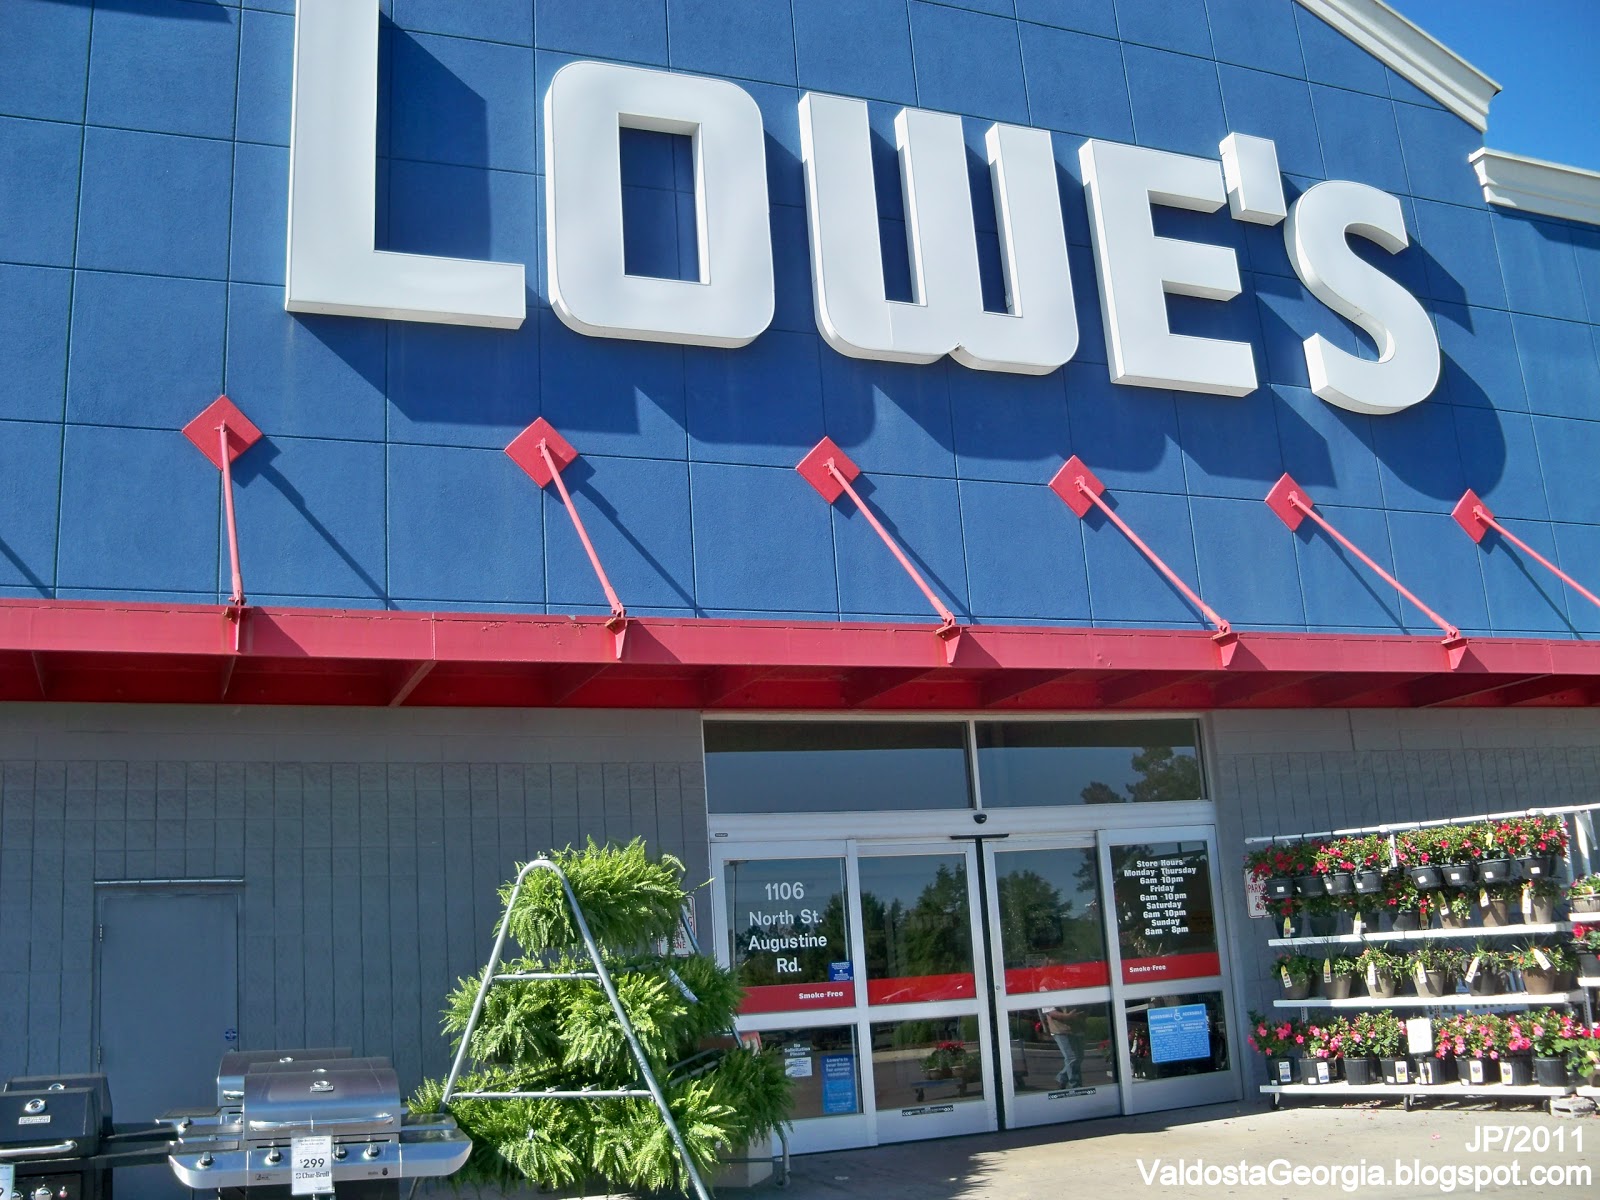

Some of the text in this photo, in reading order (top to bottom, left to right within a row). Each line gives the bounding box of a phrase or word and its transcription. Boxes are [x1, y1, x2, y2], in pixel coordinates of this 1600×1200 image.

[285, 0, 1440, 414] LOWE'S
[1136, 860, 1158, 868] Store
[1160, 867, 1197, 875] Thursday
[1140, 877, 1158, 885] 6am
[765, 881, 805, 901] 1106
[1150, 885, 1175, 893] Friday
[1140, 894, 1158, 902] 6am
[1146, 901, 1182, 910] Saturday
[749, 909, 823, 926] North St.
[1143, 911, 1160, 919] 6am
[1151, 918, 1180, 927] Sunday
[1145, 928, 1163, 936] 8am
[1171, 926, 1189, 934] 8pm
[748, 933, 828, 953] Augustine
[776, 957, 802, 973] Rd.
